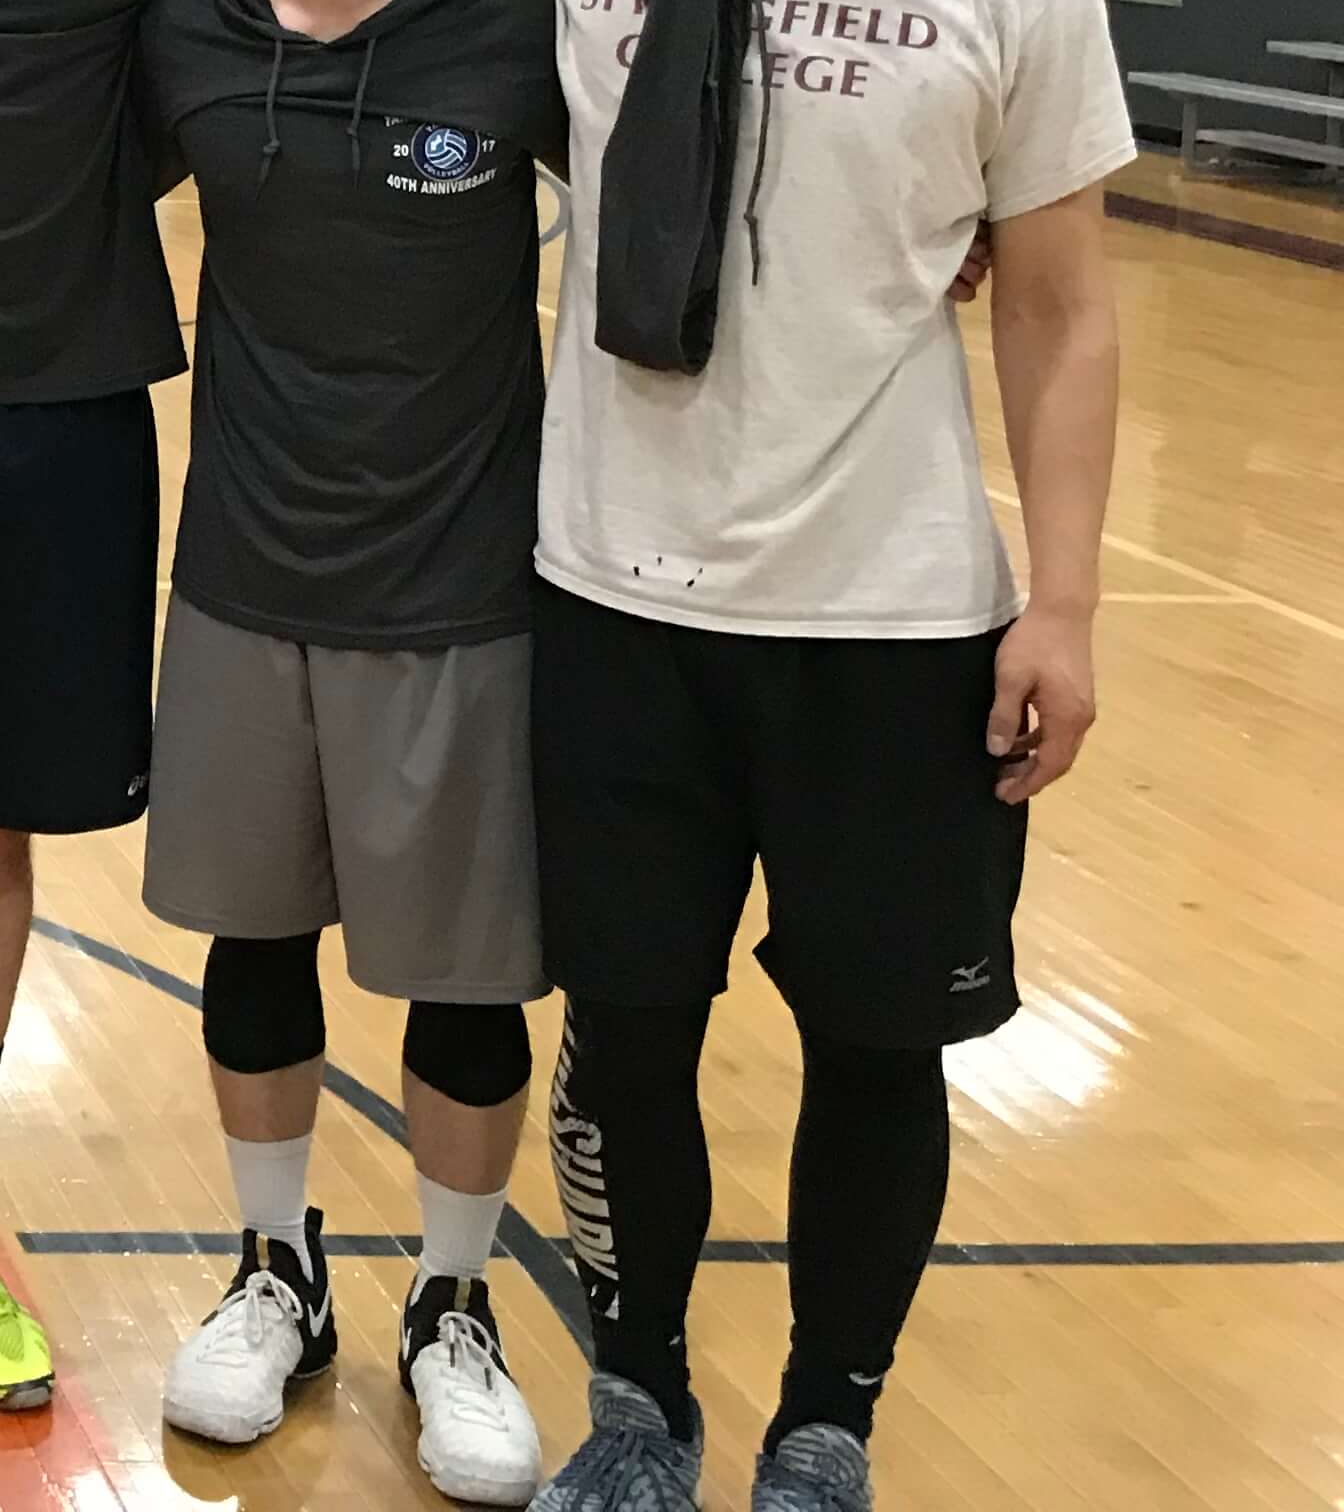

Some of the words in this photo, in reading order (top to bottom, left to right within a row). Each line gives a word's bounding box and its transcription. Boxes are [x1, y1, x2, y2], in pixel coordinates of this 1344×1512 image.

[615, 33, 871, 98] CEGE
[393, 144, 409, 158] 20
[481, 140, 497, 153] 17
[386, 173, 418, 193] 40TH
[420, 168, 498, 196] ANNIVERSARY
